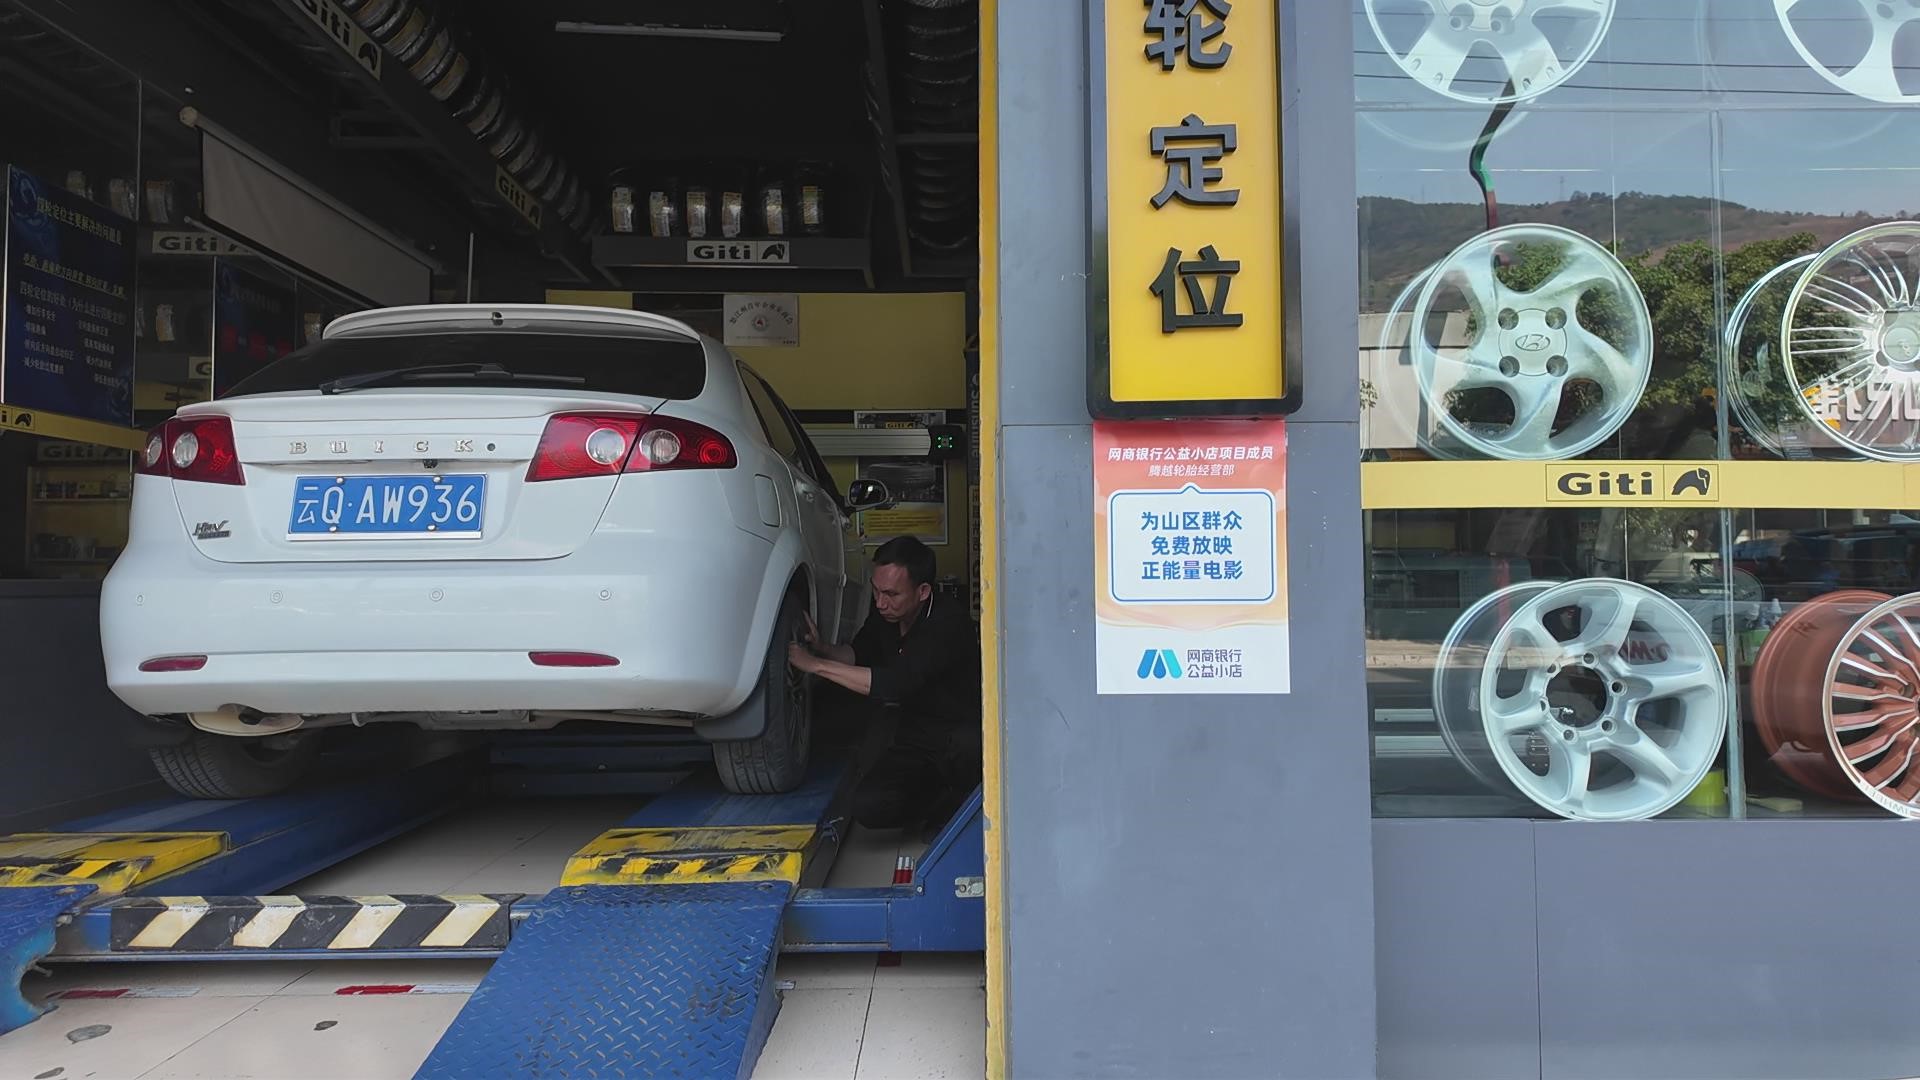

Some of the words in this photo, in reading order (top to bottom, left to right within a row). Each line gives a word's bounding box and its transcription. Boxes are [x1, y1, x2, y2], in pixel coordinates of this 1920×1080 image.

[1144, 0, 1243, 334] 轮定位
[499, 175, 526, 212] Giti
[158, 232, 218, 251] Giti
[693, 245, 751, 260] Giti
[289, 440, 474, 455] BUICK
[1108, 447, 1273, 461] 网商银行公益小店项目成员
[1148, 464, 1235, 477] 腾越轮胎经营部
[1557, 471, 1652, 495] Giti
[297, 484, 477, 524] 云Q·AW936
[1141, 511, 1243, 531] 为山区群众
[1151, 536, 1233, 556] 免费放映
[1141, 561, 1243, 581] 正能量电影
[1187, 649, 1242, 663] 网商银行
[1187, 664, 1242, 678] 公益小店
